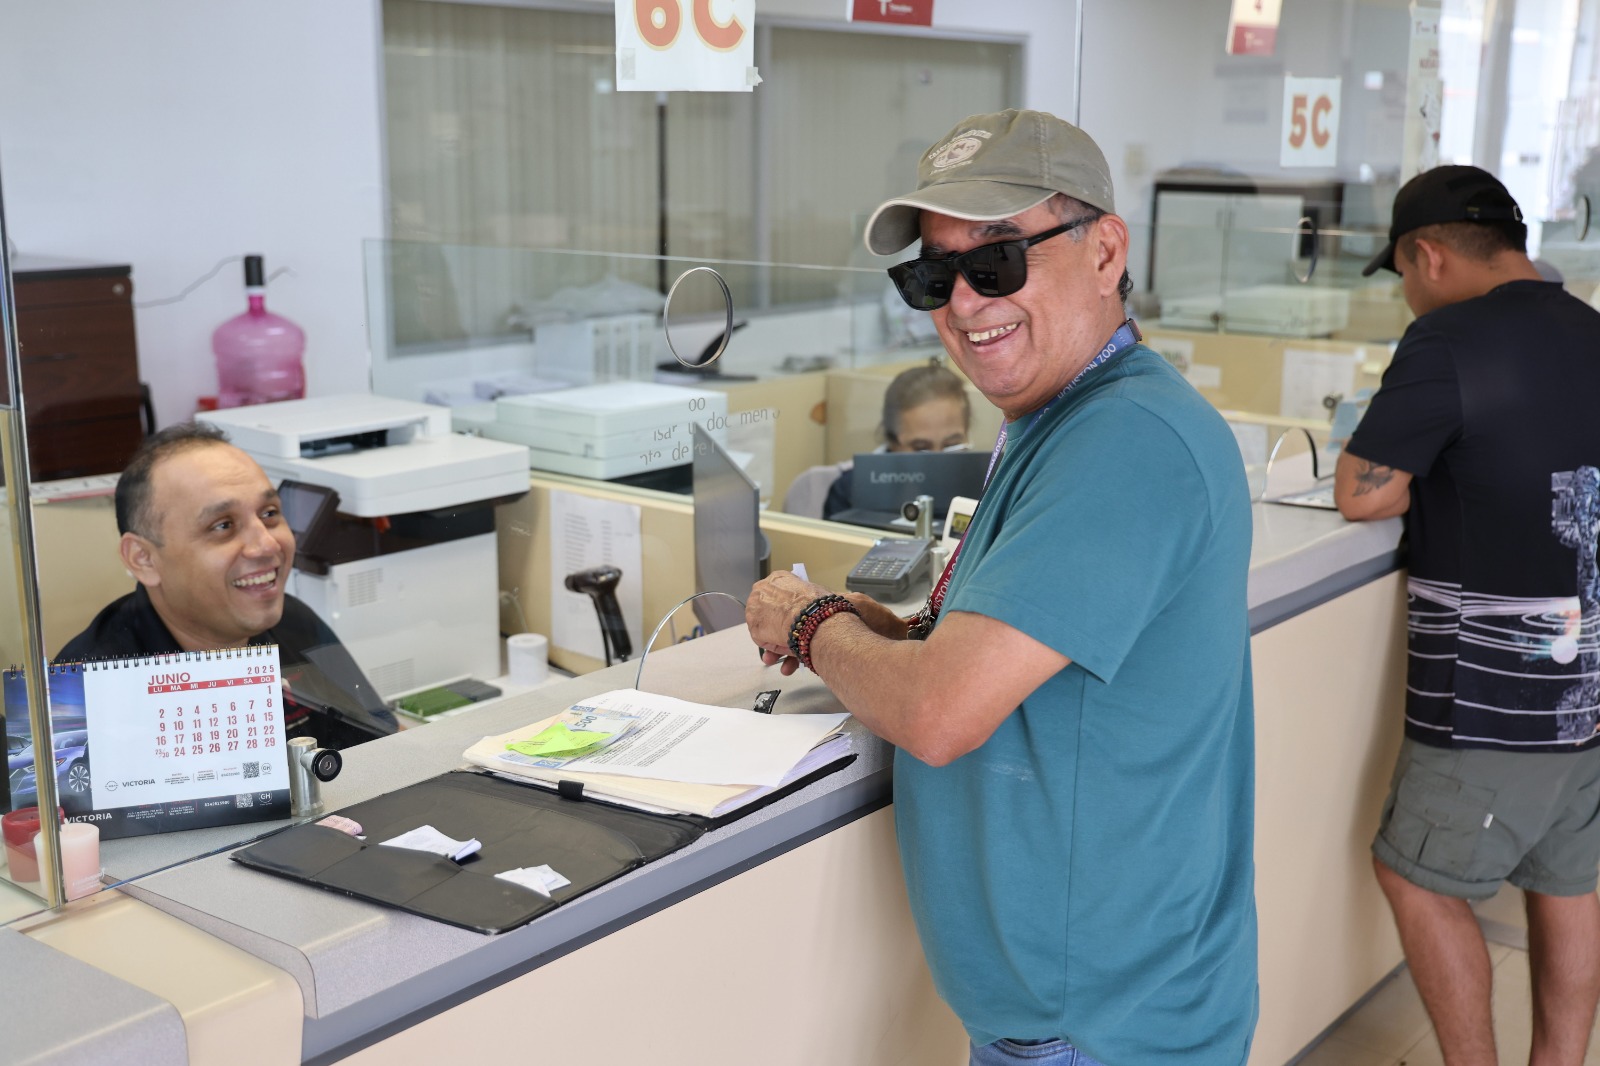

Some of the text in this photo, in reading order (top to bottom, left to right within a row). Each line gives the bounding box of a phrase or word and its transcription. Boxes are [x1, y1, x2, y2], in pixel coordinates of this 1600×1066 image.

[633, 0, 747, 53] 6C
[1288, 94, 1332, 150] 5C
[1096, 344, 1116, 363] ZOO
[870, 470, 925, 484] Lenovo
[148, 665, 274, 685] JUNIO 2025
[159, 699, 272, 718] 2 3 4 5 6 7 8
[160, 712, 273, 731] 9 10 11 12 13 14 15
[574, 716, 598, 728] 500
[156, 725, 274, 745] 16 17 18 19 20 21 22
[174, 747, 185, 756] 24
[192, 745, 203, 754] 25
[209, 743, 220, 752] 26
[228, 741, 238, 750] 27
[247, 739, 257, 748] 28
[265, 737, 275, 747] 29
[122, 778, 156, 788] VICTORIA
[66, 812, 112, 823] VICTORIA
